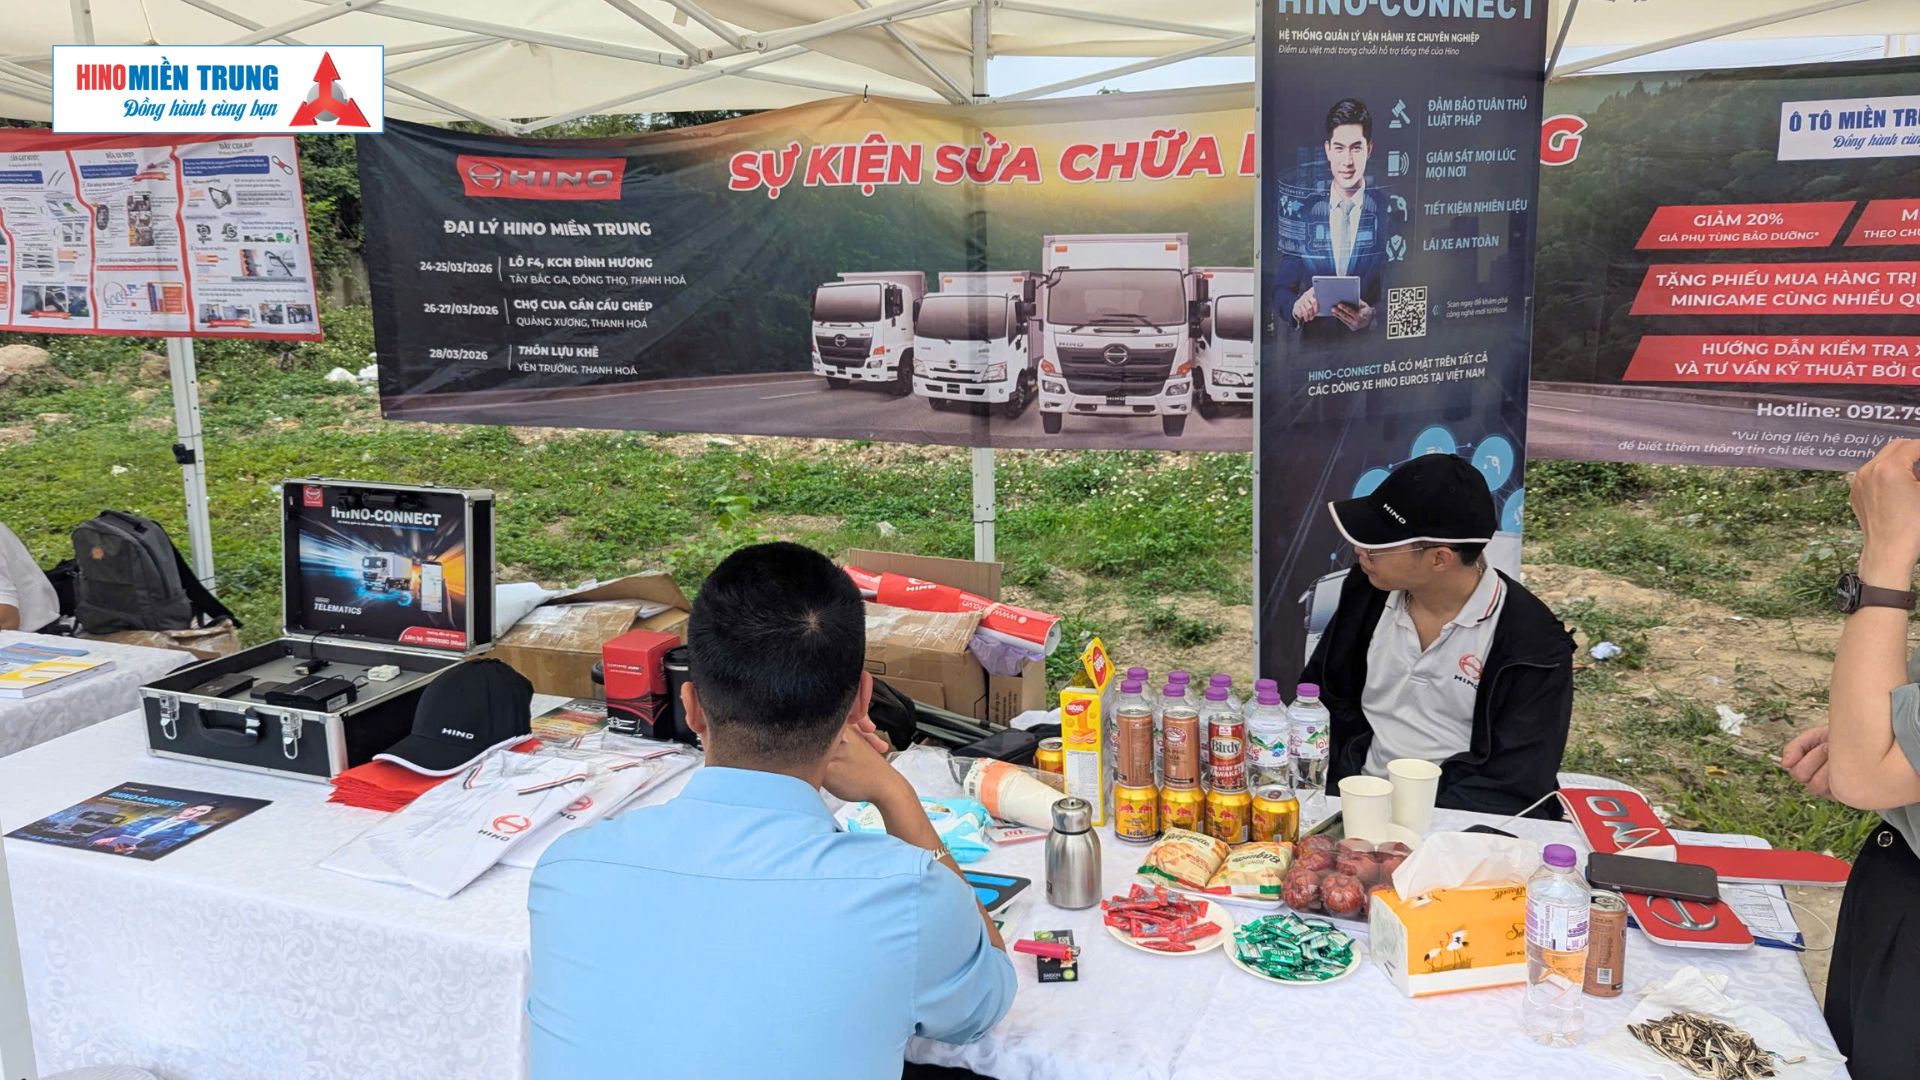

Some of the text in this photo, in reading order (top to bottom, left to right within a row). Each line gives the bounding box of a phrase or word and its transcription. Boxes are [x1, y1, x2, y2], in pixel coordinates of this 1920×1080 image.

[1279, 27, 1480, 45] HỆ THỐNG QUẢN LÝ VẬN HÀNH XE CHUYÊN NGHIỆP
[1428, 95, 1527, 111] ĐẢM BẢO TUÂN THỦ
[1428, 112, 1481, 129] LUẬT PHÁP
[1789, 110, 1802, 132] Ô
[1808, 109, 1832, 131] TÔ
[1839, 104, 1886, 129] MIỀN
[1833, 133, 1898, 150] Đồng hành
[1426, 147, 1516, 164] GIÁM SÁT MỌI LÚC
[728, 142, 801, 200] SỰ
[803, 131, 923, 197] KIỆN
[933, 131, 1042, 186] SỬA
[1059, 128, 1225, 182] CHỮA
[510, 170, 612, 188] HINO
[1426, 166, 1466, 181] MỌI NƠI
[1424, 198, 1527, 216] TIẾT KIỆM NHIÊN LIỆU
[1693, 211, 1783, 227] GIẢM 20%
[444, 218, 651, 237] ĐẠI LÝ HINO MIỀN TRUNG
[1864, 229, 1896, 239] THEO
[1424, 234, 1499, 250] LÁI XE AN TOÀN
[1659, 232, 1678, 242] GIÁ
[1682, 234, 1706, 243] PHỤ
[1710, 231, 1741, 242] TÙNG
[1741, 230, 1769, 242] BẢO
[420, 261, 492, 274] 24-25/03/2026
[509, 255, 652, 269] LÔ F4, KCN ĐÌNH HƯƠNG
[510, 274, 528, 284] TÂY
[554, 276, 570, 286] GA,
[572, 274, 602, 284] ĐÔNG
[631, 276, 661, 284] THANH
[664, 274, 686, 285] HOÁ
[1656, 268, 1917, 289] TẶNG PHIẾU MUA HÀNG TRỊ
[514, 299, 538, 312] CHỢ
[542, 300, 566, 310] CUA
[622, 300, 652, 312] GHÉP
[1671, 294, 1767, 306] MINIGAME
[1772, 290, 1826, 306] CÙNG
[424, 303, 499, 315] 26-27/03/2026
[516, 315, 648, 328] QUẢNG XƯƠNG, THANH HOÁ
[430, 349, 488, 360] 28/03/2026
[518, 344, 547, 356] THÔN
[576, 345, 599, 357] KHÊ
[1702, 338, 1908, 356] HƯỚNG DẪN KIỂM TRA
[518, 361, 637, 375] YÊN TRƯỜNG, THANH HOÁ
[1308, 351, 1488, 382] HINO-CONNECT ĐÃ CÓ MẶT TRÊN TẤT CẢ
[1675, 360, 1906, 380] VÀ TƯ VẤN KỸ THUẬT BỞI
[1308, 368, 1485, 396] CÁC DÒNG XE HINO EURO5 TẠI VIỆT NAM
[1757, 402, 1840, 418] Hotline:
[1761, 431, 1791, 444] lòng
[1795, 432, 1819, 443] liên
[1822, 433, 1840, 444] hệ
[1844, 434, 1869, 446] Đại
[1871, 434, 1884, 446] lý
[1638, 440, 1662, 451] biết
[1666, 441, 1700, 452] thêm
[1704, 444, 1743, 456] thông
[1747, 444, 1765, 455] tin
[1769, 444, 1789, 456] chi
[1792, 444, 1814, 456] tiết
[1819, 446, 1835, 457] và
[1839, 447, 1875, 458] danh
[1383, 503, 1407, 525] HINO
[314, 603, 362, 615] TELEMATICS
[442, 728, 474, 740] HINO
[1212, 740, 1239, 753] Birdy
[478, 829, 510, 842] HINO
